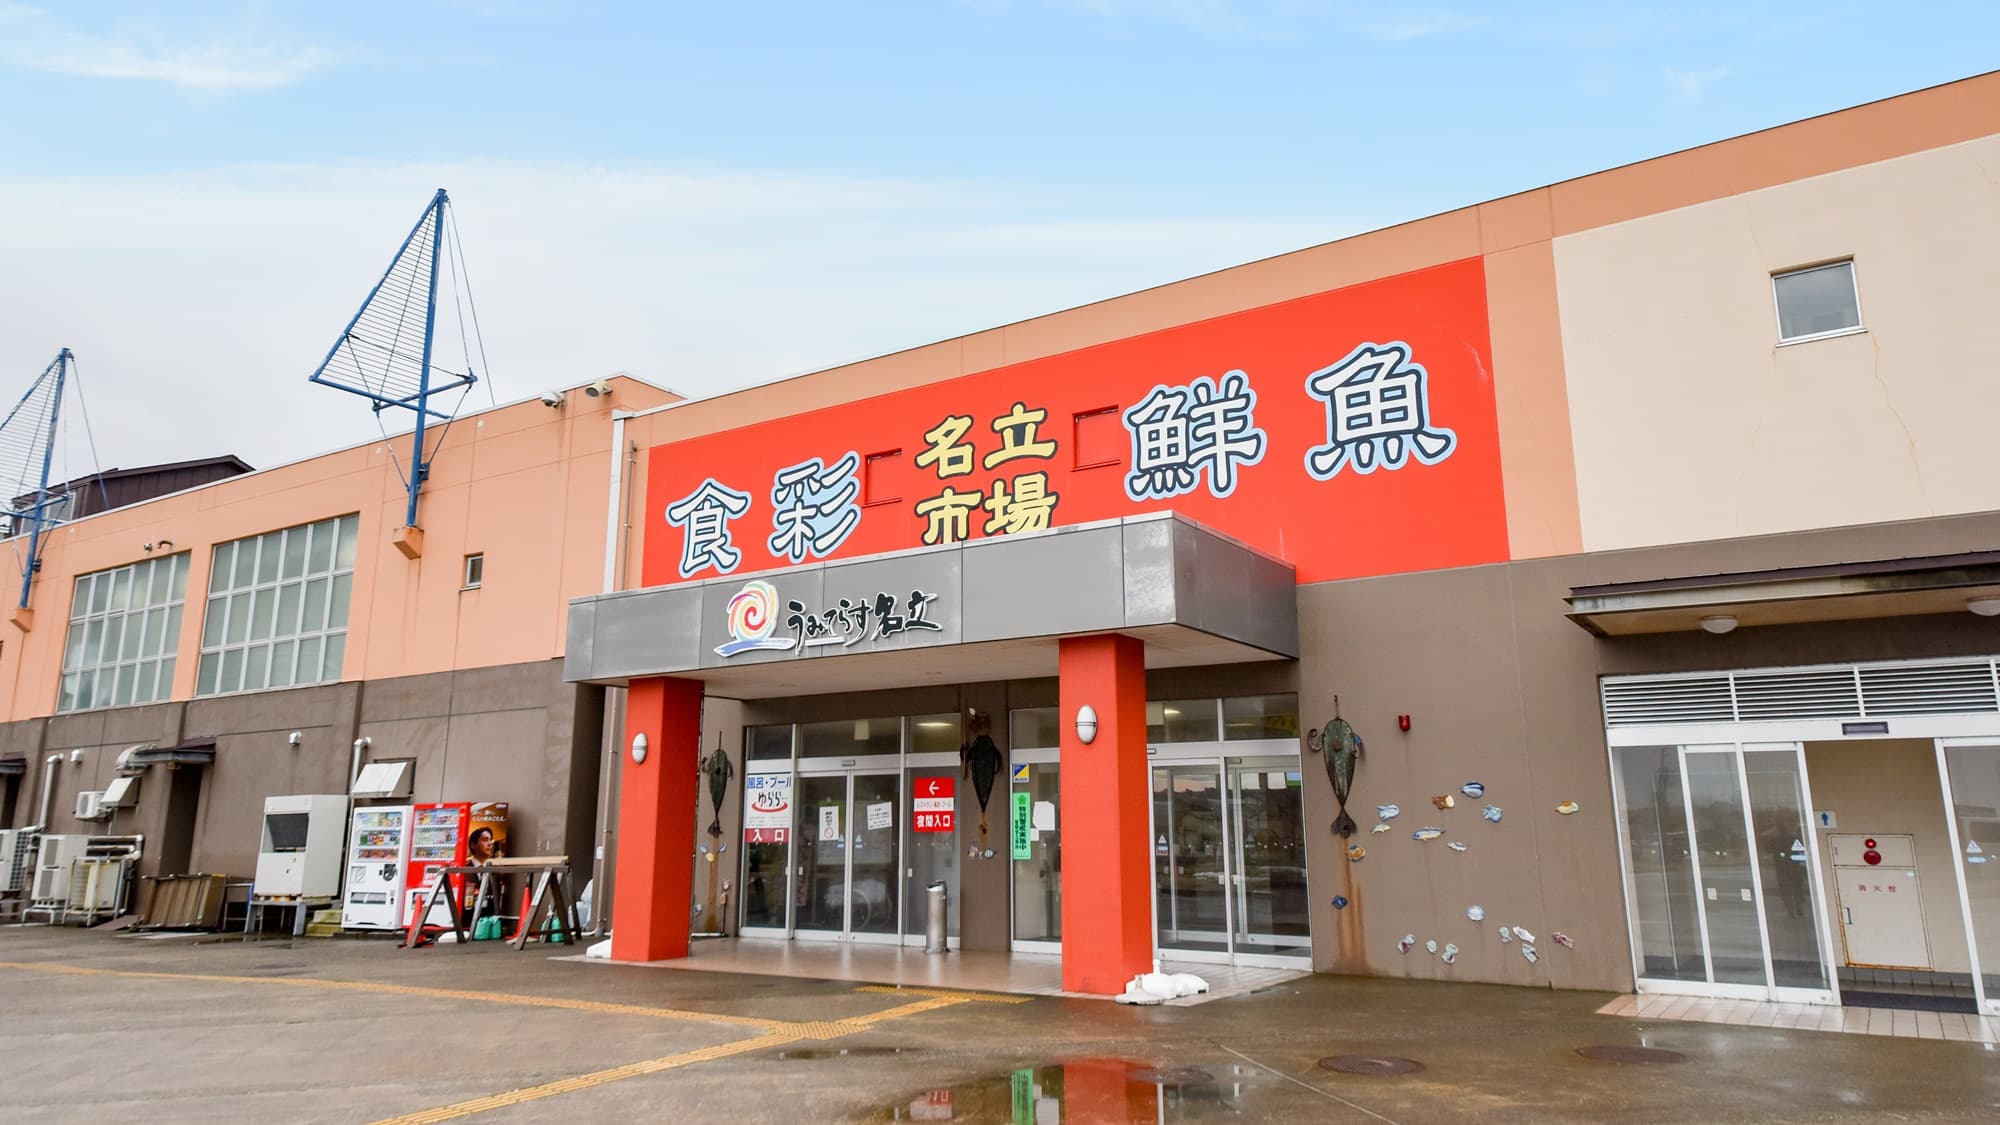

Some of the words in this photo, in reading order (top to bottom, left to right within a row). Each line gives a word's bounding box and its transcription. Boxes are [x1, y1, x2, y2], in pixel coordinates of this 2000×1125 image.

[915, 402, 1057, 479] 名立
[1123, 341, 1457, 501] 鮮魚
[666, 450, 861, 578] 食彩
[915, 471, 1059, 544] 市場
[787, 590, 943, 655] うみてらす名立
[752, 829, 785, 842] 入口
